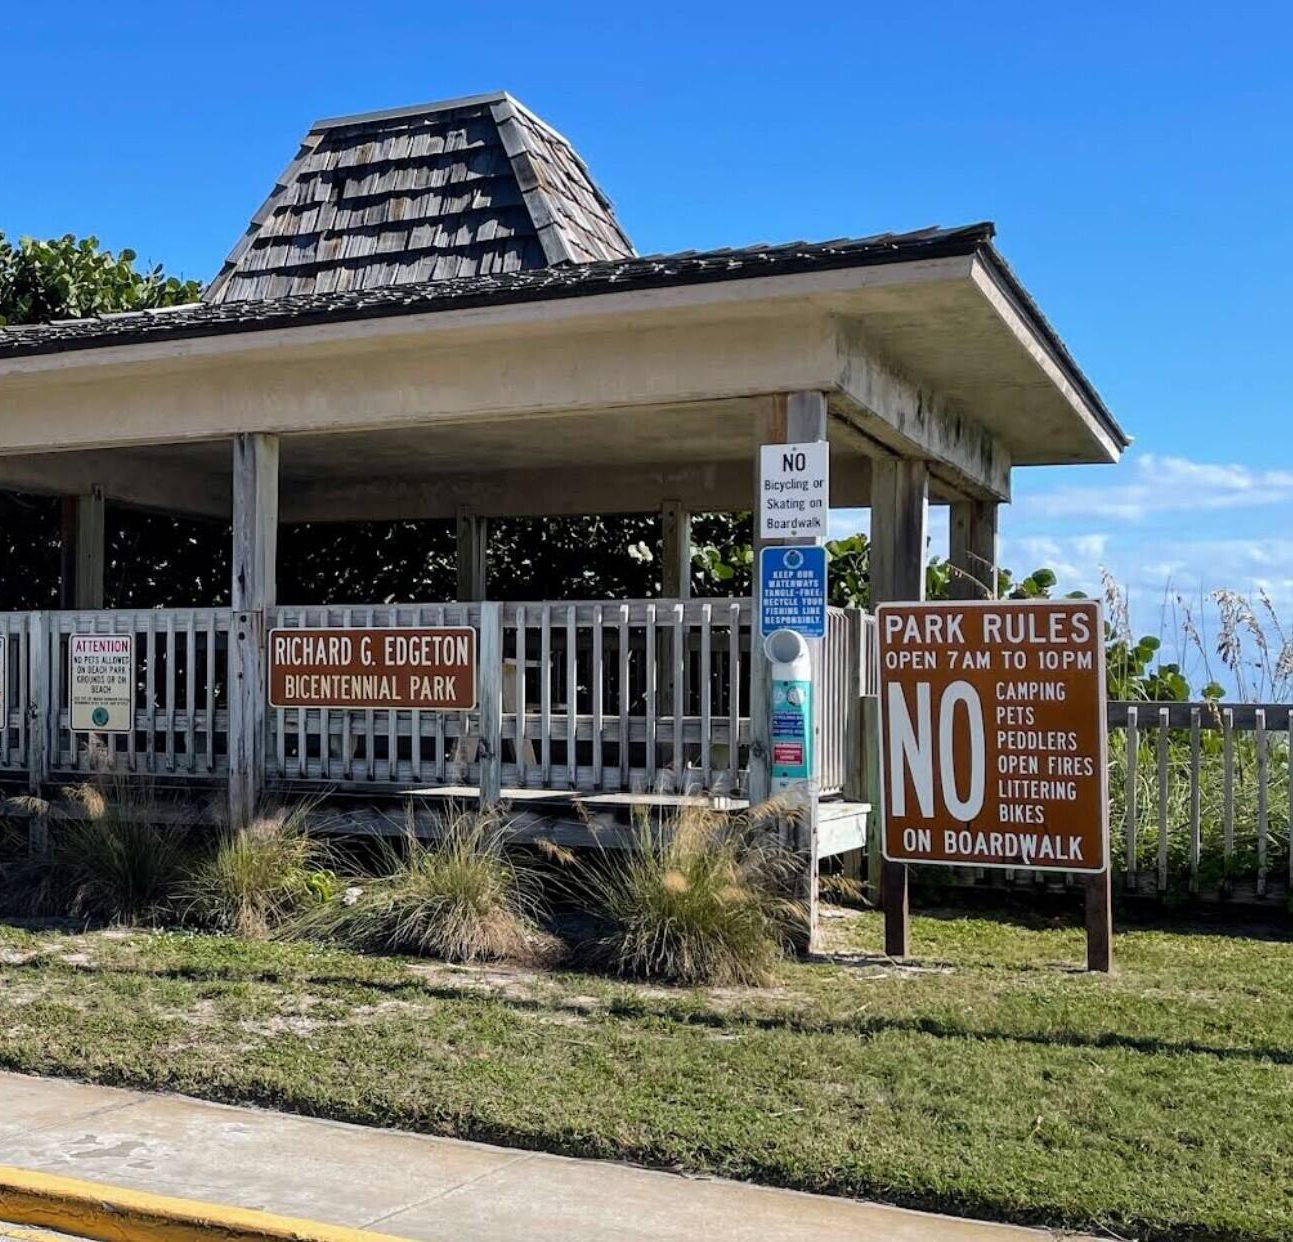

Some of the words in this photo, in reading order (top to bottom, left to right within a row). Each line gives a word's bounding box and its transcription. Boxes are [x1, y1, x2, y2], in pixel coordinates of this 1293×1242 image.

[783, 452, 806, 472] NO
[764, 479, 809, 492] Bicycling
[813, 479, 824, 488] or
[766, 498, 805, 511] Skating
[809, 499, 822, 508] on
[766, 517, 821, 529] Boardwalk
[768, 579, 819, 588] WATERWAYS
[773, 570, 794, 579] KEEP
[797, 570, 814, 579] OUR
[763, 598, 798, 606] RECYCLE
[802, 597, 823, 606] YOUR
[765, 607, 799, 615] FISHING
[802, 607, 820, 615] LINE
[885, 614, 965, 644] PARK
[983, 612, 1090, 644] RULES
[76, 640, 128, 652] ATTENTION
[274, 636, 352, 666] RICHARD
[360, 637, 376, 666] G.
[384, 635, 469, 667] EDGETON
[74, 656, 82, 664] NO
[84, 656, 99, 664] PETS
[102, 656, 129, 664] ALLOWED
[886, 651, 937, 669] OPEN
[1002, 651, 1028, 669] TO
[77, 666, 85, 674] ON
[88, 666, 107, 674] BEACH
[109, 666, 125, 674] PARK
[77, 676, 105, 684] GROUNDS
[107, 676, 115, 684] OR
[118, 676, 126, 684] ON
[91, 685, 111, 693] BEACH
[285, 675, 402, 700] BICENTENNIAL
[410, 676, 456, 701] PARK
[996, 682, 1066, 701] CAMPING
[996, 706, 1035, 725] PETS
[997, 731, 1078, 751] PEDDLERS
[887, 680, 986, 822] NO
[998, 755, 1039, 775] OPEN
[1048, 756, 1094, 776] FIRES
[998, 780, 1077, 800] LITTERING
[999, 804, 1045, 824] BIKES
[903, 828, 932, 853] ON
[944, 830, 1083, 862] BOARDWALK
